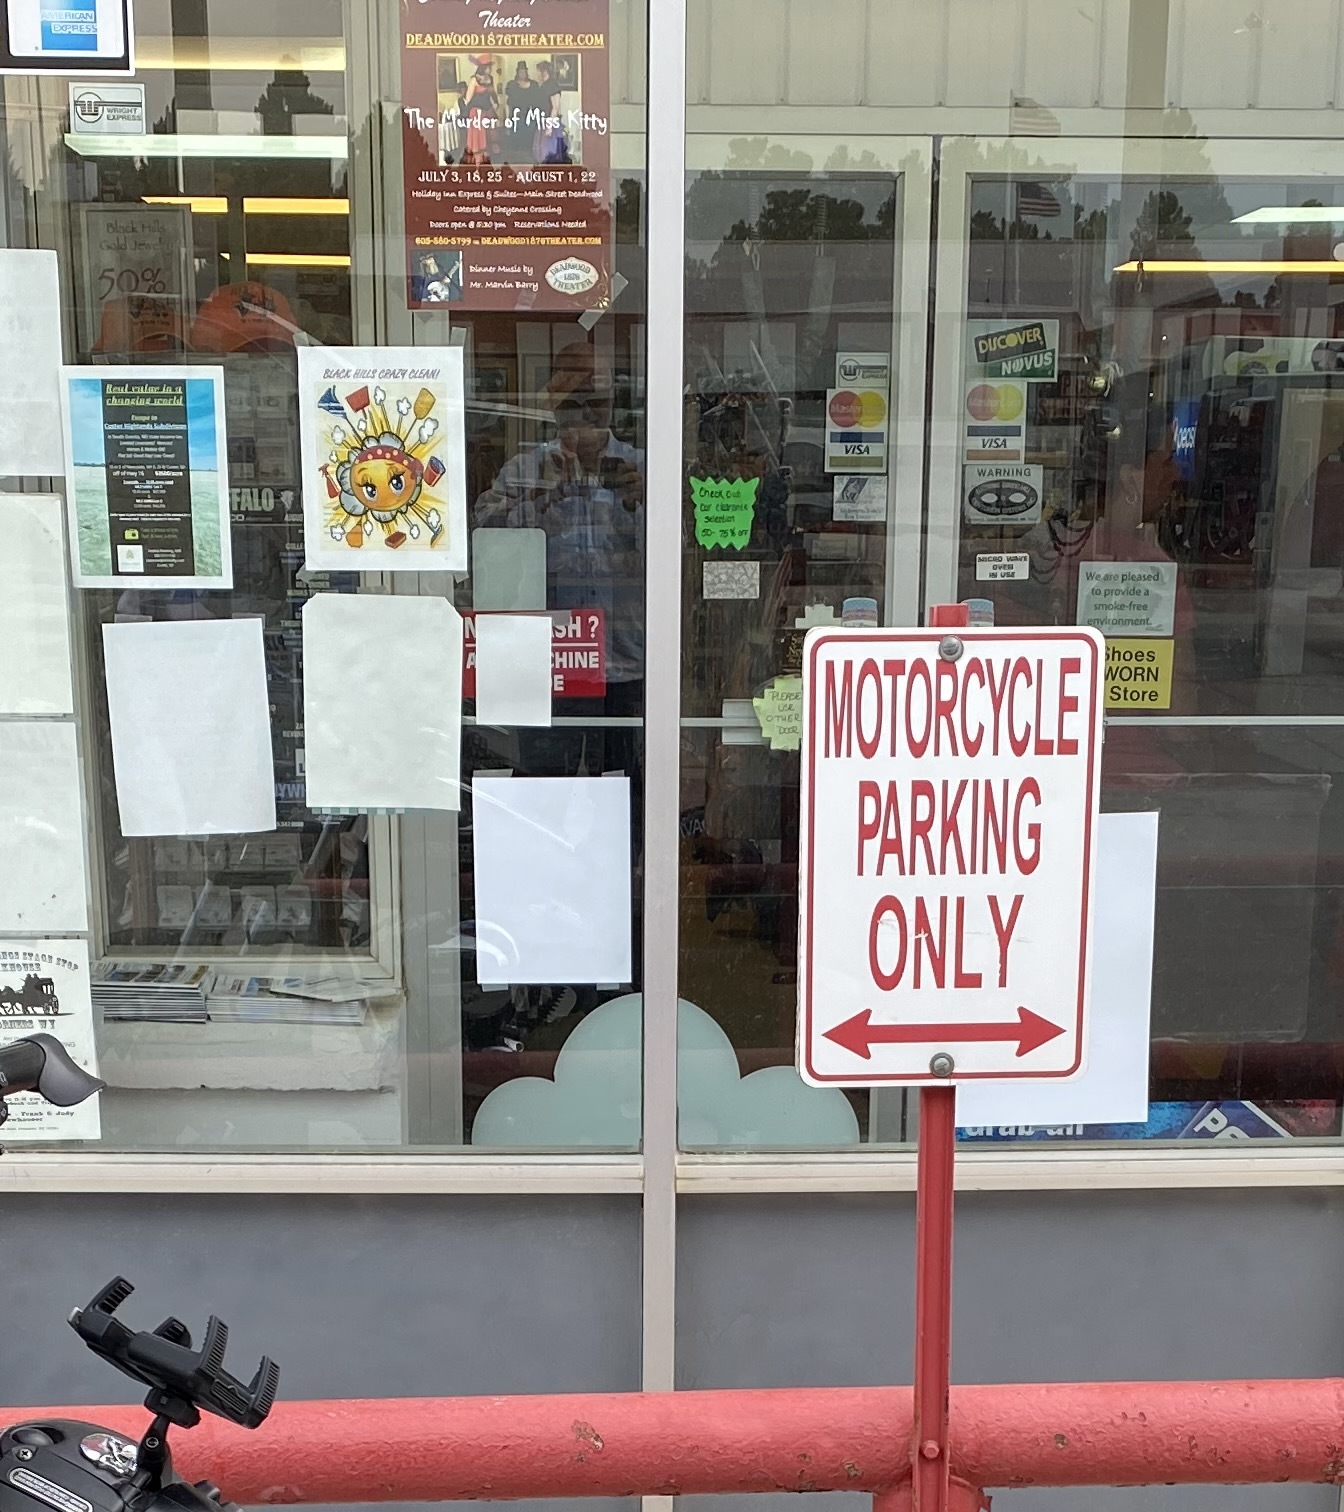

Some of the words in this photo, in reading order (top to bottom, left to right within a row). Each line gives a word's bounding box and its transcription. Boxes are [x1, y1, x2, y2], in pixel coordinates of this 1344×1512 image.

[41, 10, 94, 21] AMERICAN
[478, 10, 532, 29] Theater
[53, 24, 98, 33] EXPRESS
[406, 33, 605, 48] DEADWOOD1876THEATER.COM
[404, 107, 435, 131] The
[441, 107, 498, 131] Murder
[505, 107, 521, 134] of
[526, 107, 560, 131] Miss
[568, 106, 608, 135] Kitty
[418, 169, 449, 183] JULY
[451, 170, 463, 184] 3,
[487, 170, 503, 182] 25
[516, 170, 564, 184] AUGUST
[581, 170, 597, 183] 22
[412, 189, 441, 200] Holiday
[458, 189, 485, 200] Express
[545, 189, 567, 198] Street
[568, 189, 604, 198] Deadwood
[530, 205, 562, 216] Crossing
[430, 220, 450, 229] Doors
[451, 221, 467, 230] open
[514, 220, 560, 229] Reservations
[561, 220, 587, 229] Needed
[469, 264, 496, 274] Dinner
[523, 264, 534, 276] by
[978, 327, 1043, 354] DISCOVER
[1001, 351, 1054, 376] NOVUS
[323, 368, 352, 379] BLACK
[353, 368, 378, 379] HILLS
[378, 368, 408, 380] CRAZY
[408, 368, 441, 380] CLEAN!
[154, 395, 184, 406] world
[981, 438, 1008, 448] VISA
[844, 445, 870, 455] VISA
[977, 467, 1032, 478] WARNING
[231, 487, 275, 512] FALO
[1085, 571, 1102, 582] We
[1103, 573, 1119, 582] are
[1121, 572, 1160, 583] pleased
[1091, 587, 1102, 596] to
[1103, 586, 1142, 598] provide
[1143, 588, 1150, 597] a
[1093, 601, 1149, 612] smoke-free
[1087, 616, 1153, 627] environment.
[770, 691, 801, 701] PLEASE
[1109, 685, 1159, 702] Store
[824, 656, 1081, 759] MOTORCYCLE
[766, 712, 801, 723] OTHER
[857, 776, 1042, 877] PARKING
[868, 894, 1025, 992] ONLY
